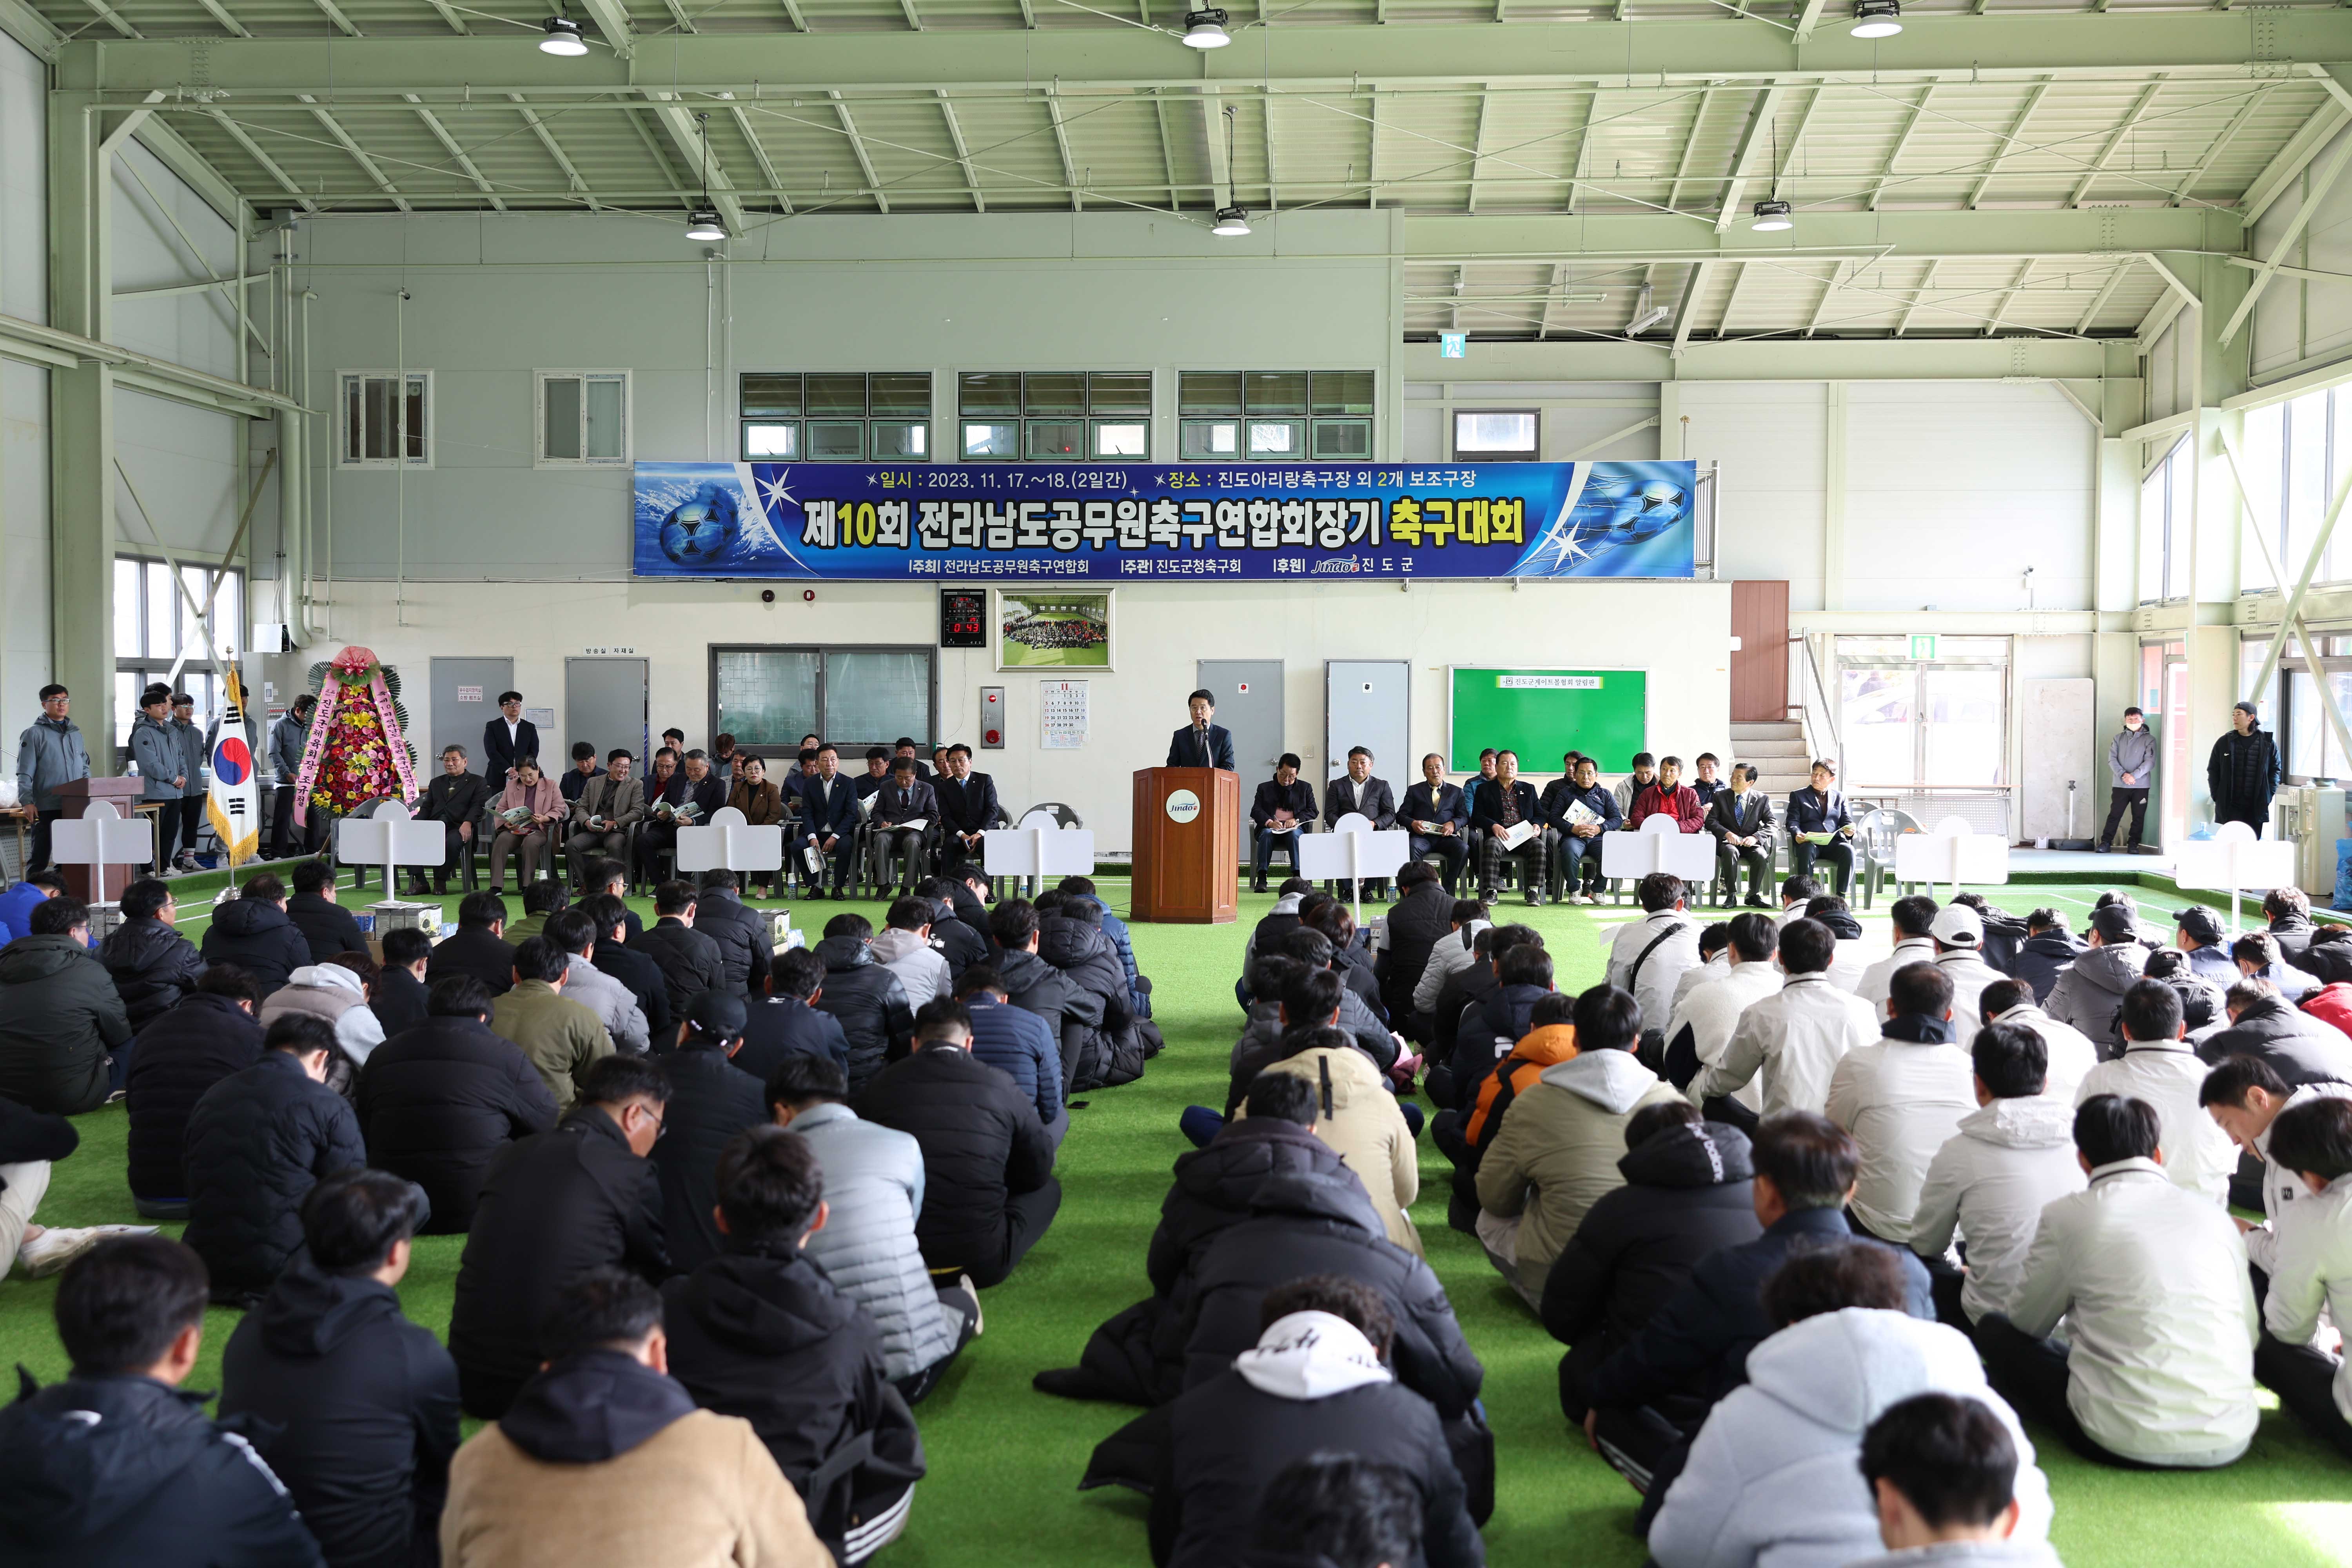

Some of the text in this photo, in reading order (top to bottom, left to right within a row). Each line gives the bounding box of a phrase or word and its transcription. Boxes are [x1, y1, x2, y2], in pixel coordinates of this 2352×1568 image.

[880, 472, 911, 488] 일시
[929, 473, 974, 488] 2023.
[981, 473, 1000, 488] 11.
[1169, 472, 1201, 489] 장소
[1218, 471, 1351, 488] 진도아리랑축구장
[1356, 471, 1371, 488] 외
[1378, 470, 1403, 488] 2개
[1409, 470, 1477, 488] 보조구장
[803, 499, 1523, 547] 제10회 전라남도공무원축구연합회장기 축구대회
[944, 559, 1089, 574] 전라남도공무원축구연합회
[1156, 559, 1241, 573] 진도군청축구회
[304, 699, 332, 770] 진도군체육회장
[296, 775, 311, 807] 조규철
